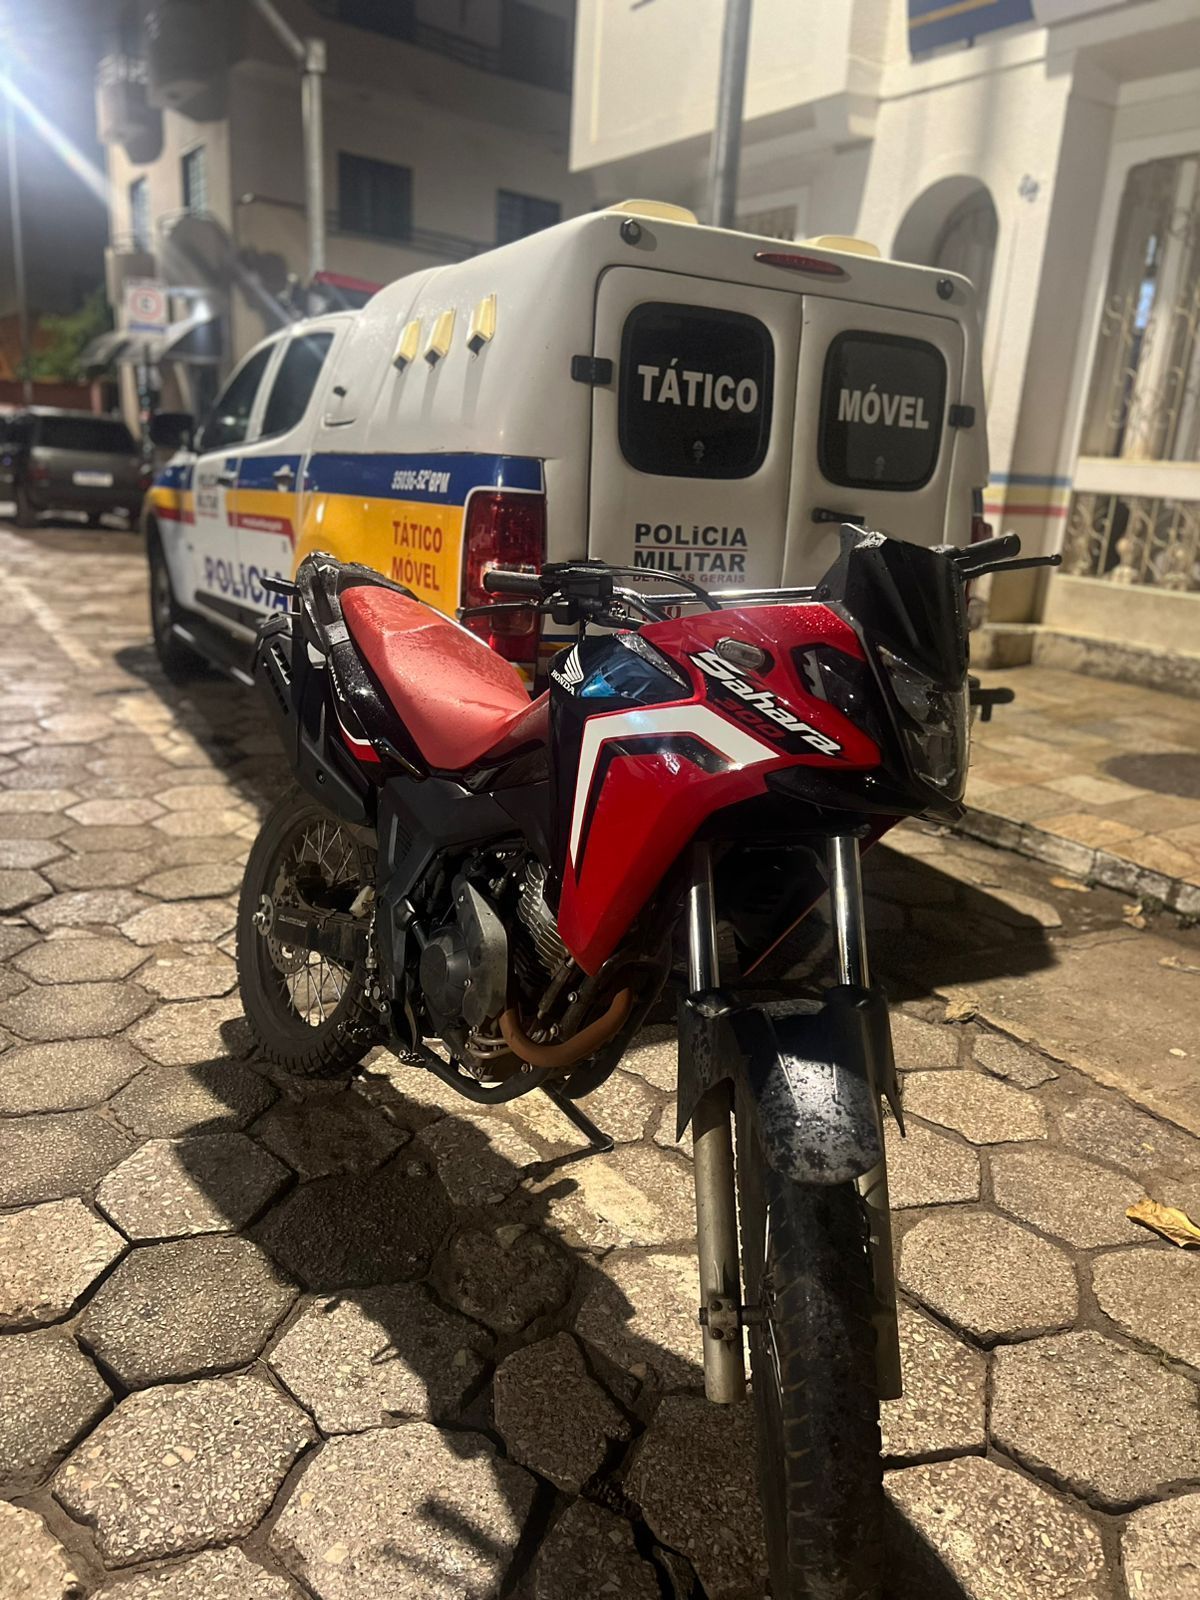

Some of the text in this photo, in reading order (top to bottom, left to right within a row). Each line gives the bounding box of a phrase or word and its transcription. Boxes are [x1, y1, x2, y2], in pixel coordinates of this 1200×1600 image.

[637, 357, 759, 413] TÁTICO
[837, 383, 930, 430] MÓVEL
[392, 515, 443, 554] TÁTICO
[391, 553, 440, 592] MÓVEL
[634, 550, 746, 573] MILITAR
[699, 573, 746, 584] GERAIS
[550, 669, 575, 696] HONDA
[689, 651, 841, 756] Sahara
[712, 697, 786, 739] 300
